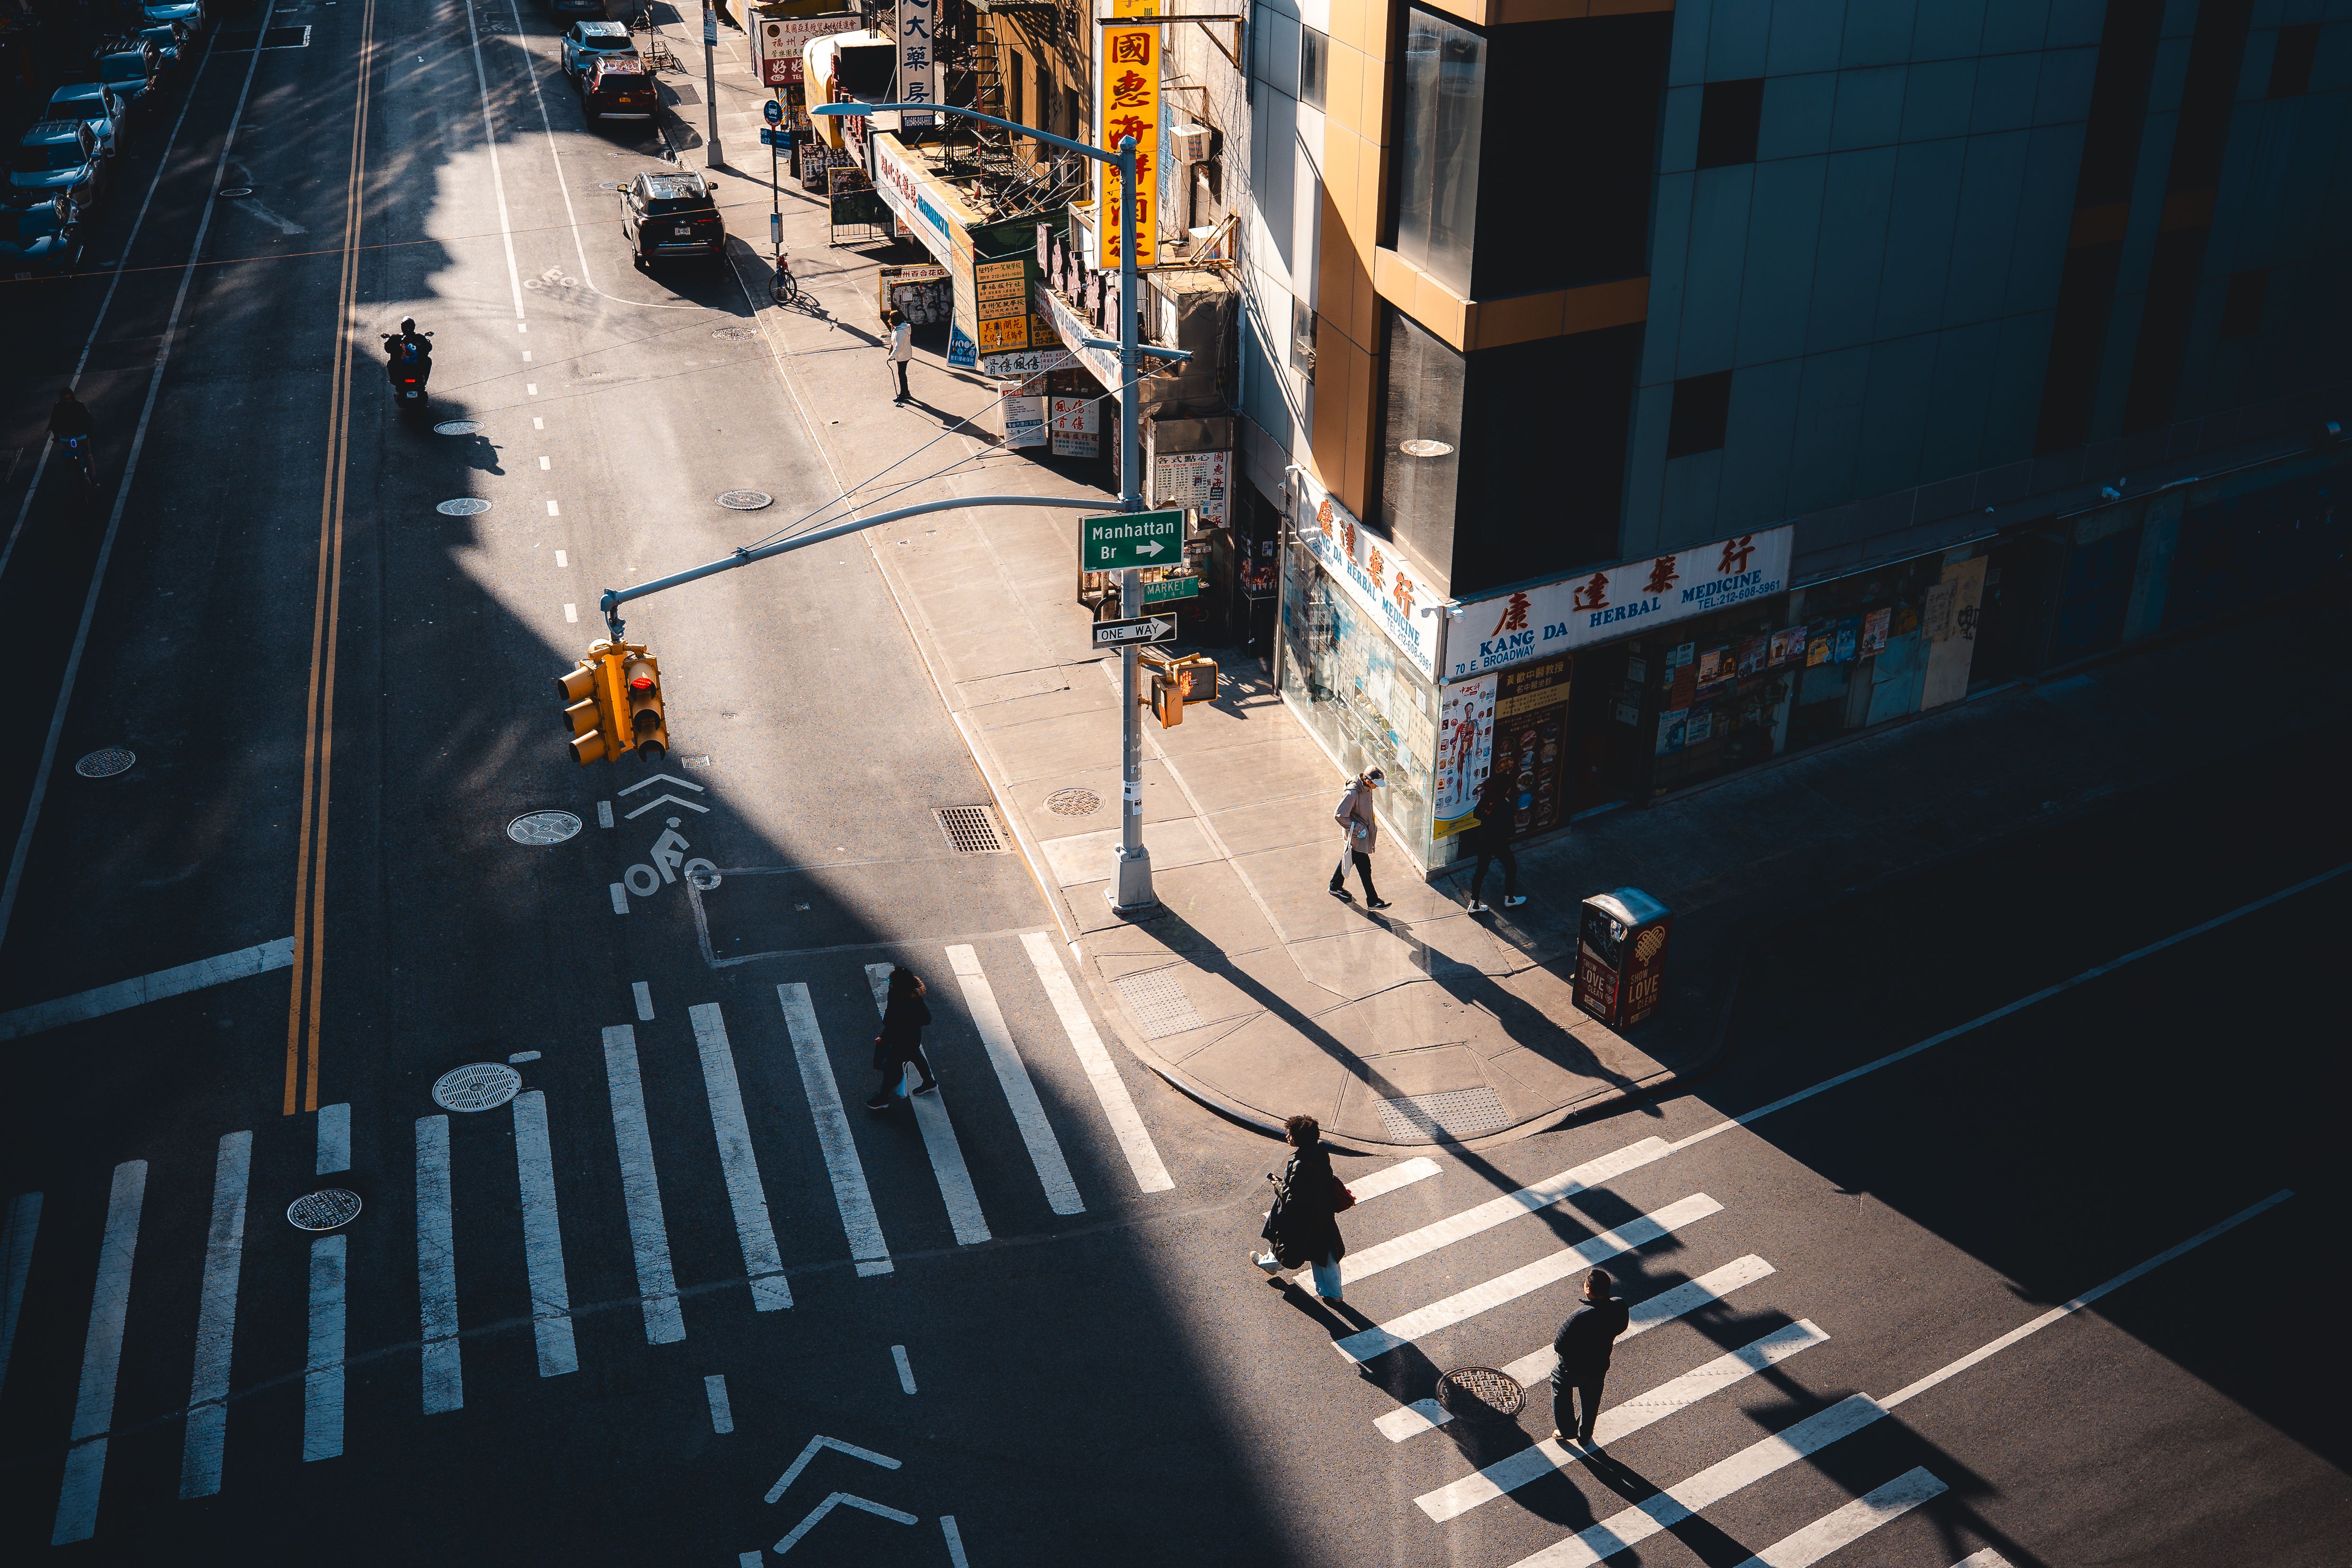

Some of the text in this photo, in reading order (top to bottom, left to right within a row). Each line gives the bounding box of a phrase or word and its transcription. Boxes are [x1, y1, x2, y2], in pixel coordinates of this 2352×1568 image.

[1085, 334, 1115, 379] STAURANT
[1158, 454, 1210, 464] 各式點心
[1212, 452, 1224, 526] 國惠海家
[1093, 522, 1174, 540] Manhattan
[1101, 547, 1116, 559] Br
[1312, 540, 1334, 568] BROADWAY
[1147, 580, 1185, 595] MARKET
[1333, 544, 1342, 566] DA
[1347, 563, 1376, 602] HERBAL
[1382, 596, 1420, 646] MEDICINE
[1698, 579, 1781, 610] TEL:212-608-5961
[1479, 570, 1762, 657] KANG DA HERBAL MEDICINE
[1101, 623, 1159, 641] ONE WAY
[1455, 644, 1536, 675] 70 E. BROADWAY
[1583, 959, 1597, 972] SHOW
[1631, 968, 1648, 985] SHOW
[1581, 966, 1604, 992] LOVE
[1629, 974, 1659, 1004] LOVE
[1588, 984, 1604, 999] CLEAN
[1638, 995, 1657, 1009] CLEAN
